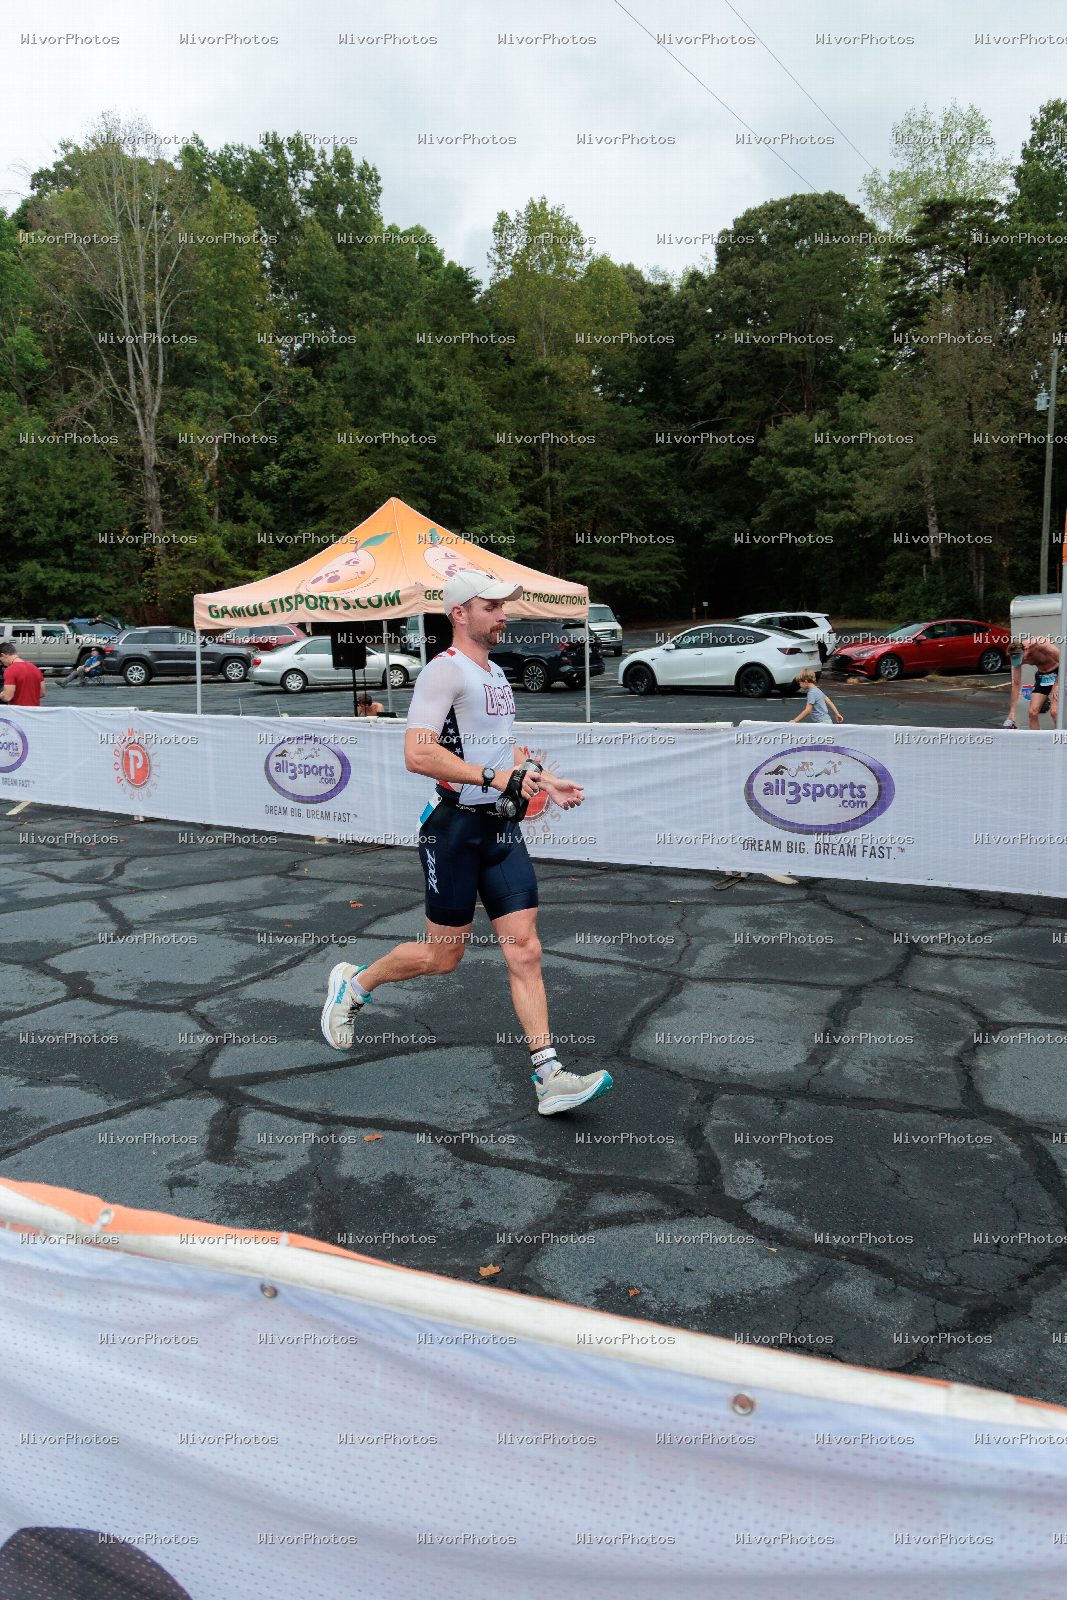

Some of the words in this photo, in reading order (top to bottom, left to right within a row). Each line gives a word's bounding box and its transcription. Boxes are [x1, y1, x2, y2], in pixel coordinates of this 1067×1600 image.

[208, 589, 402, 619] GAMULTISPORTS.COM
[532, 592, 587, 606] PRODUCTIONS
[274, 760, 335, 780] all3sports
[318, 776, 336, 785] .com
[762, 779, 867, 805] all3sports
[264, 804, 288, 816] DREAM
[306, 808, 331, 821] DREAM
[838, 800, 868, 809] .com
[742, 838, 782, 853] DREAM
[786, 841, 809, 855] BIG.
[814, 842, 857, 858] DREAM
